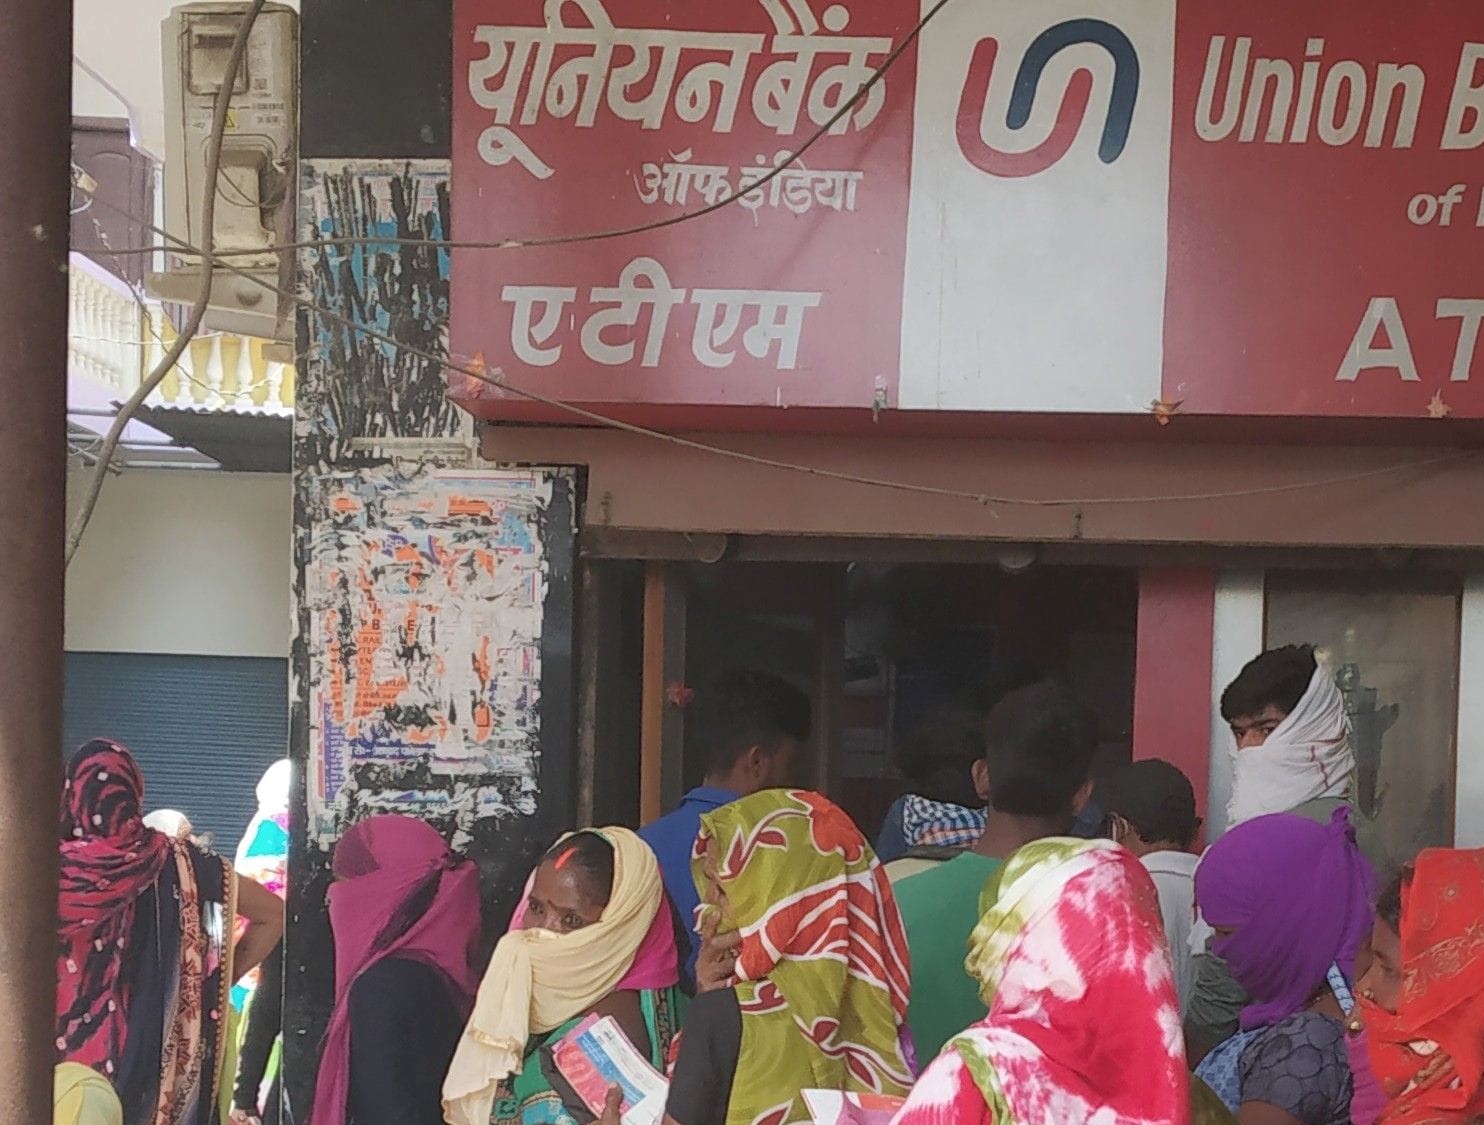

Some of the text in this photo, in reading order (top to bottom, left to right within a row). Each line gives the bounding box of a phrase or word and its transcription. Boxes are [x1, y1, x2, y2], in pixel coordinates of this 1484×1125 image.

[467, 0, 894, 179] यूनियन बैंक
[1194, 35, 1427, 149] Union
[1407, 184, 1466, 227] of
